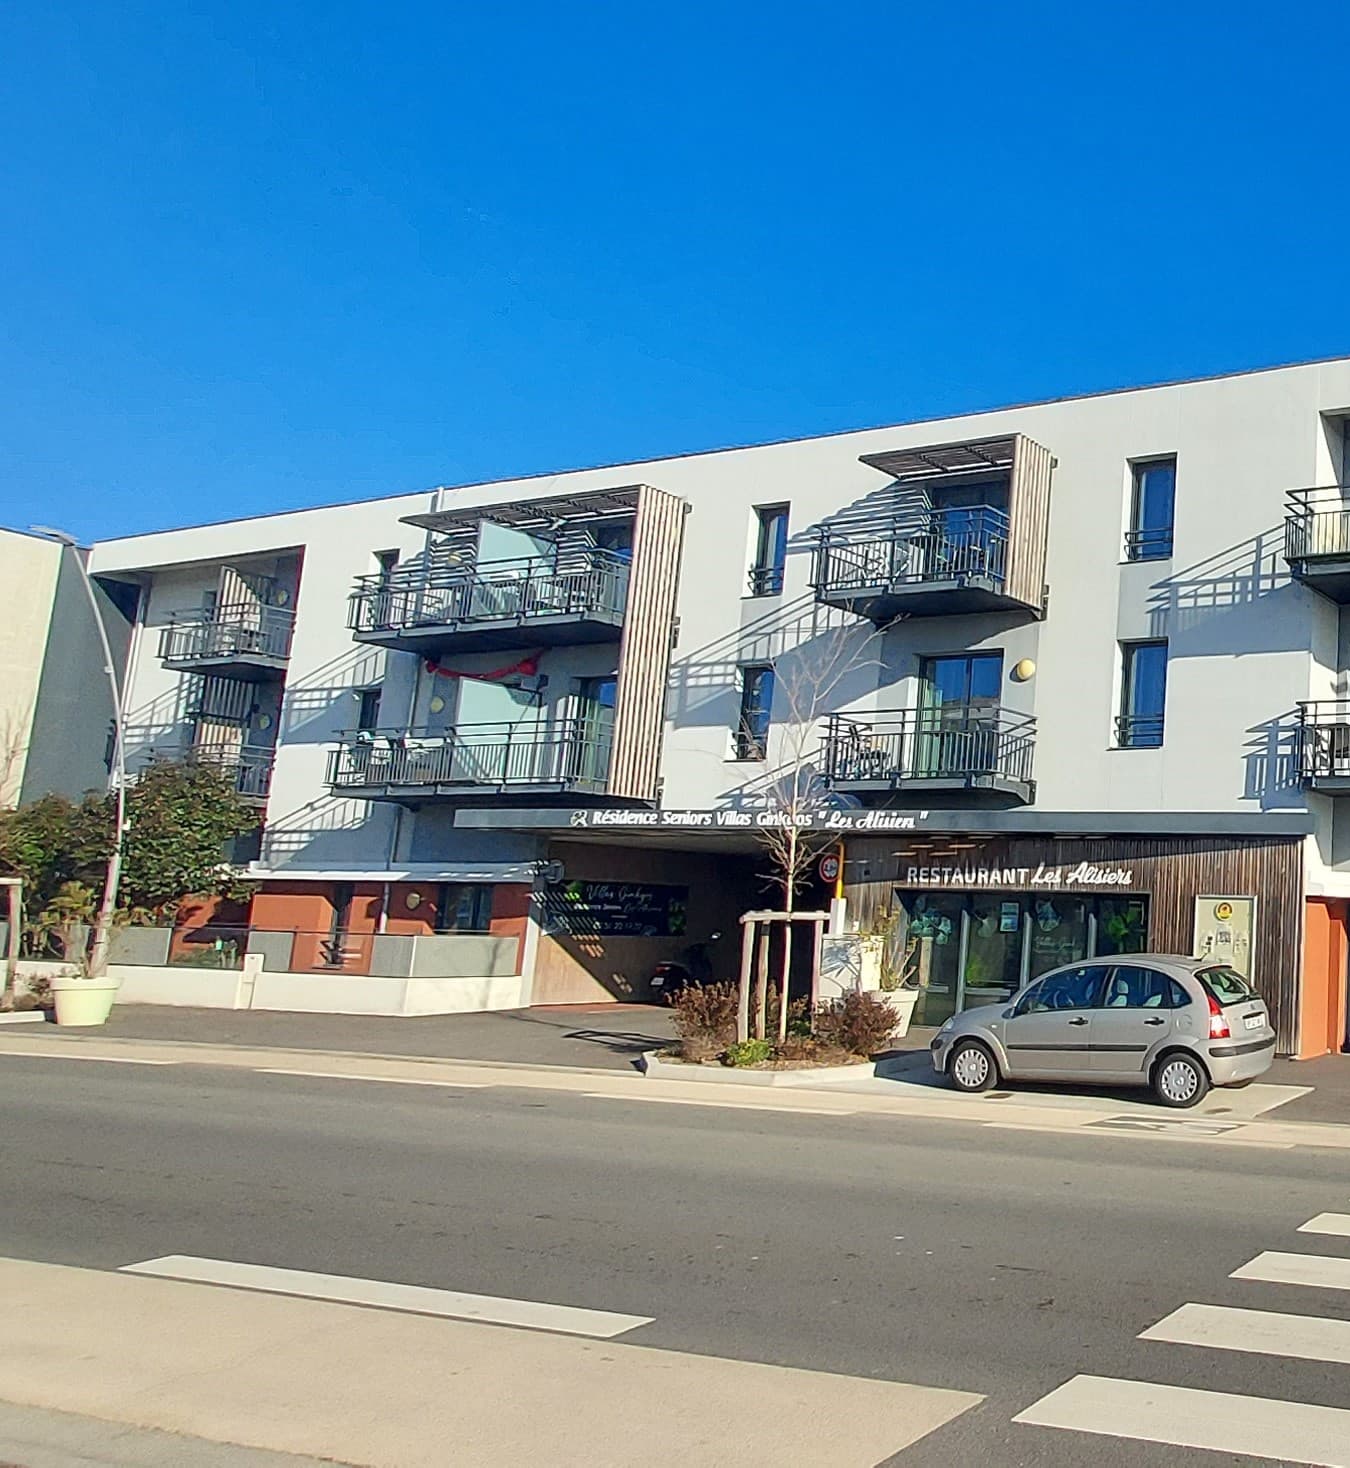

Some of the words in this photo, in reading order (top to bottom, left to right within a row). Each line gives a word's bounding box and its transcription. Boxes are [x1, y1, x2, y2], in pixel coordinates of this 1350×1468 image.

[592, 809, 658, 826] Résidence
[661, 810, 713, 826] Seniors
[716, 810, 753, 827] Villas
[906, 866, 1030, 884] RESTAURANT
[1030, 861, 1062, 884] Les
[1066, 860, 1133, 885] Alisiers
